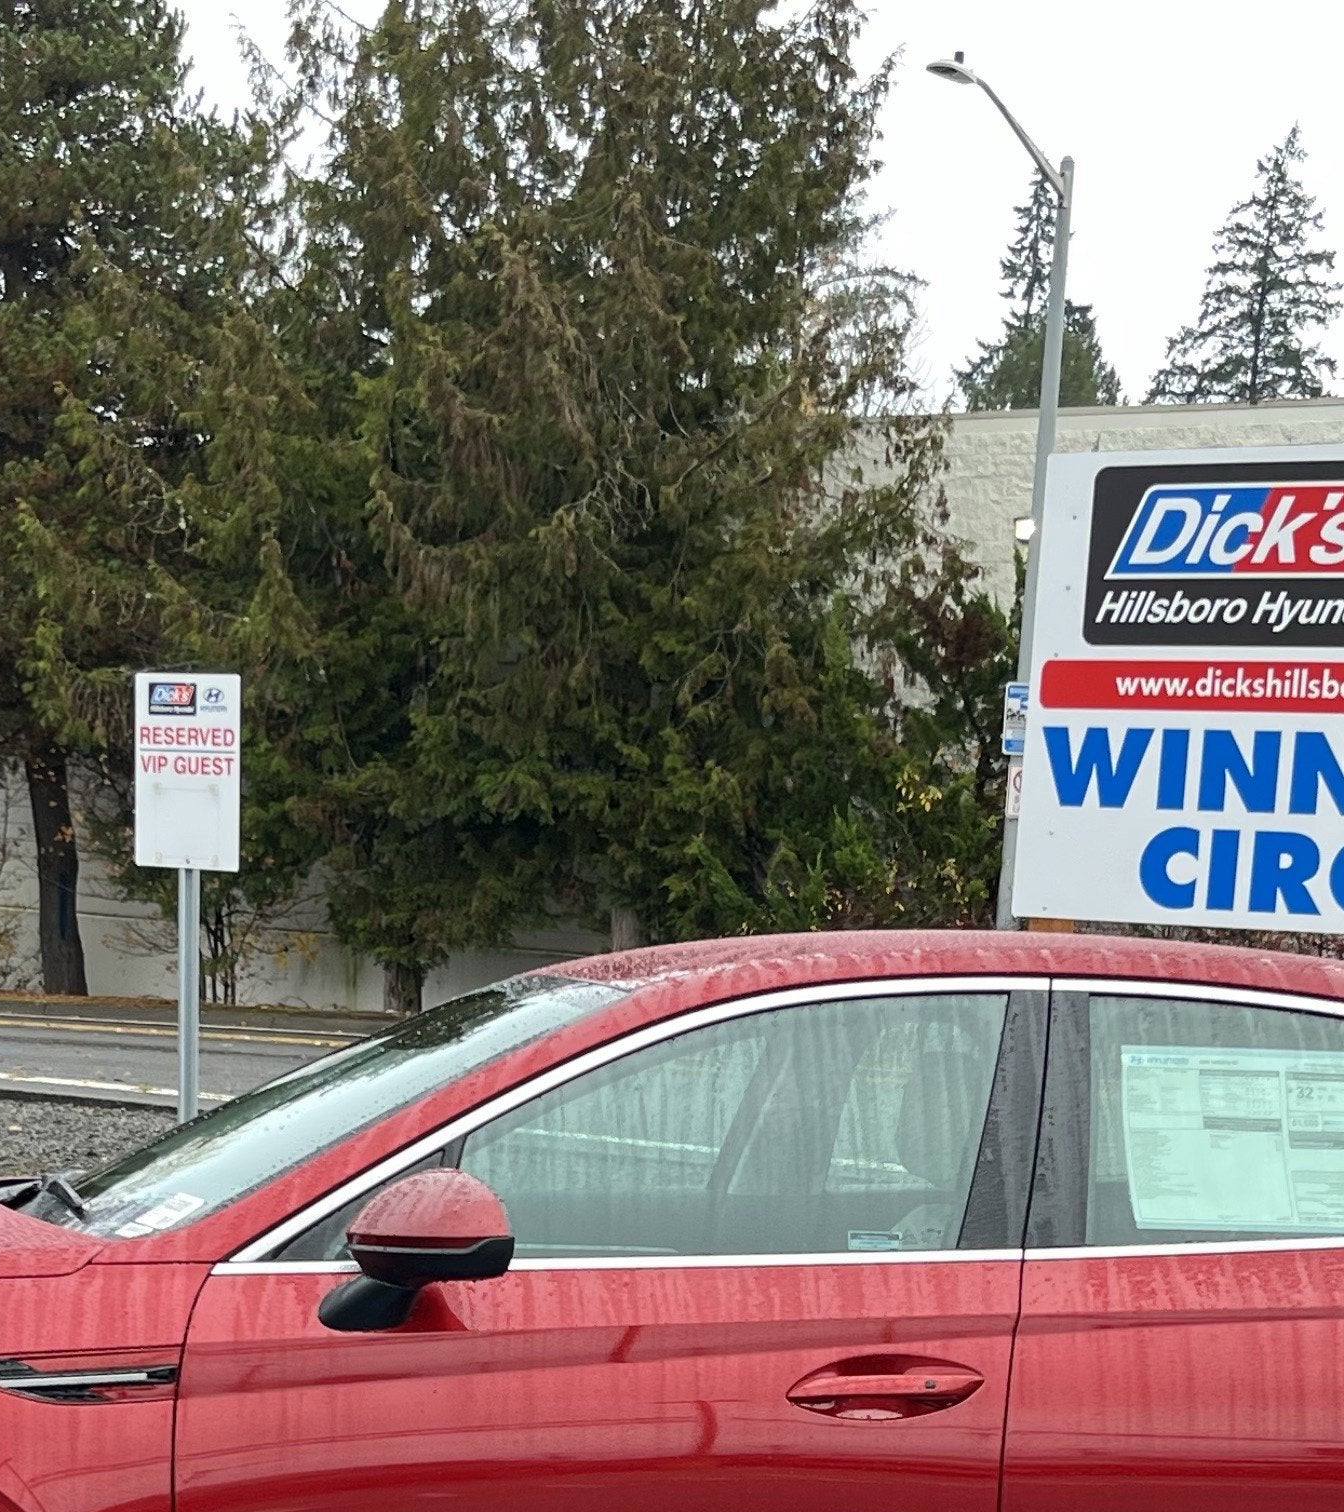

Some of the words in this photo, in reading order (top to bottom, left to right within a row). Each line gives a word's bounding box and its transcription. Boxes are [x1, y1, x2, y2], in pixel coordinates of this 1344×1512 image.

[1095, 591, 1248, 624] Hillsboro
[139, 726, 236, 746] RESERVED
[141, 755, 168, 773] VIP
[174, 756, 235, 775] GUEST
